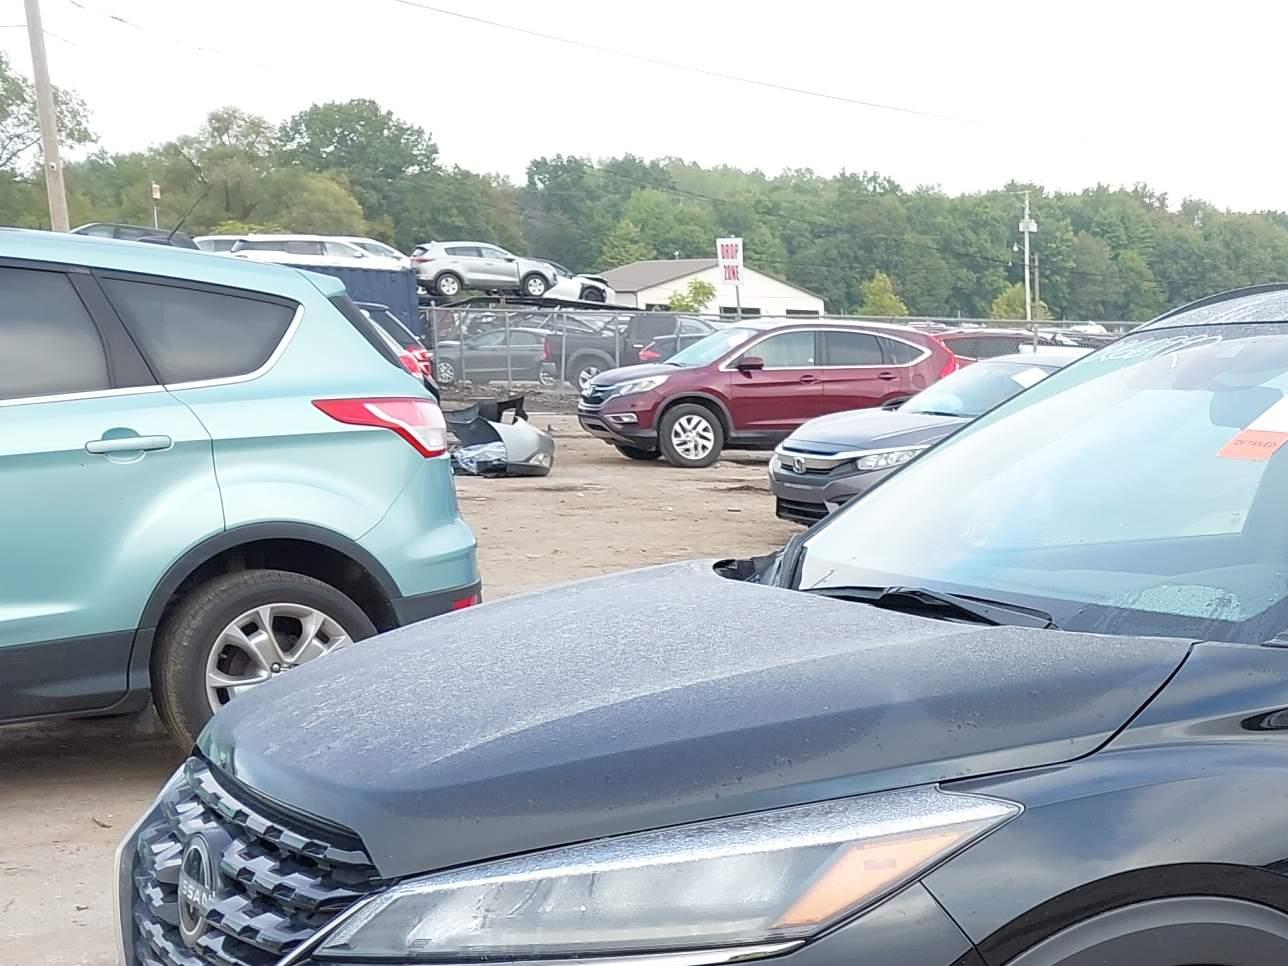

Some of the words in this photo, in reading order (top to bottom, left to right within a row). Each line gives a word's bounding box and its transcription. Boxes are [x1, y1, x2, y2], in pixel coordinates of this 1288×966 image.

[720, 243, 739, 260] DROP
[723, 264, 740, 281] ZONE
[182, 879, 216, 905] SSAN
